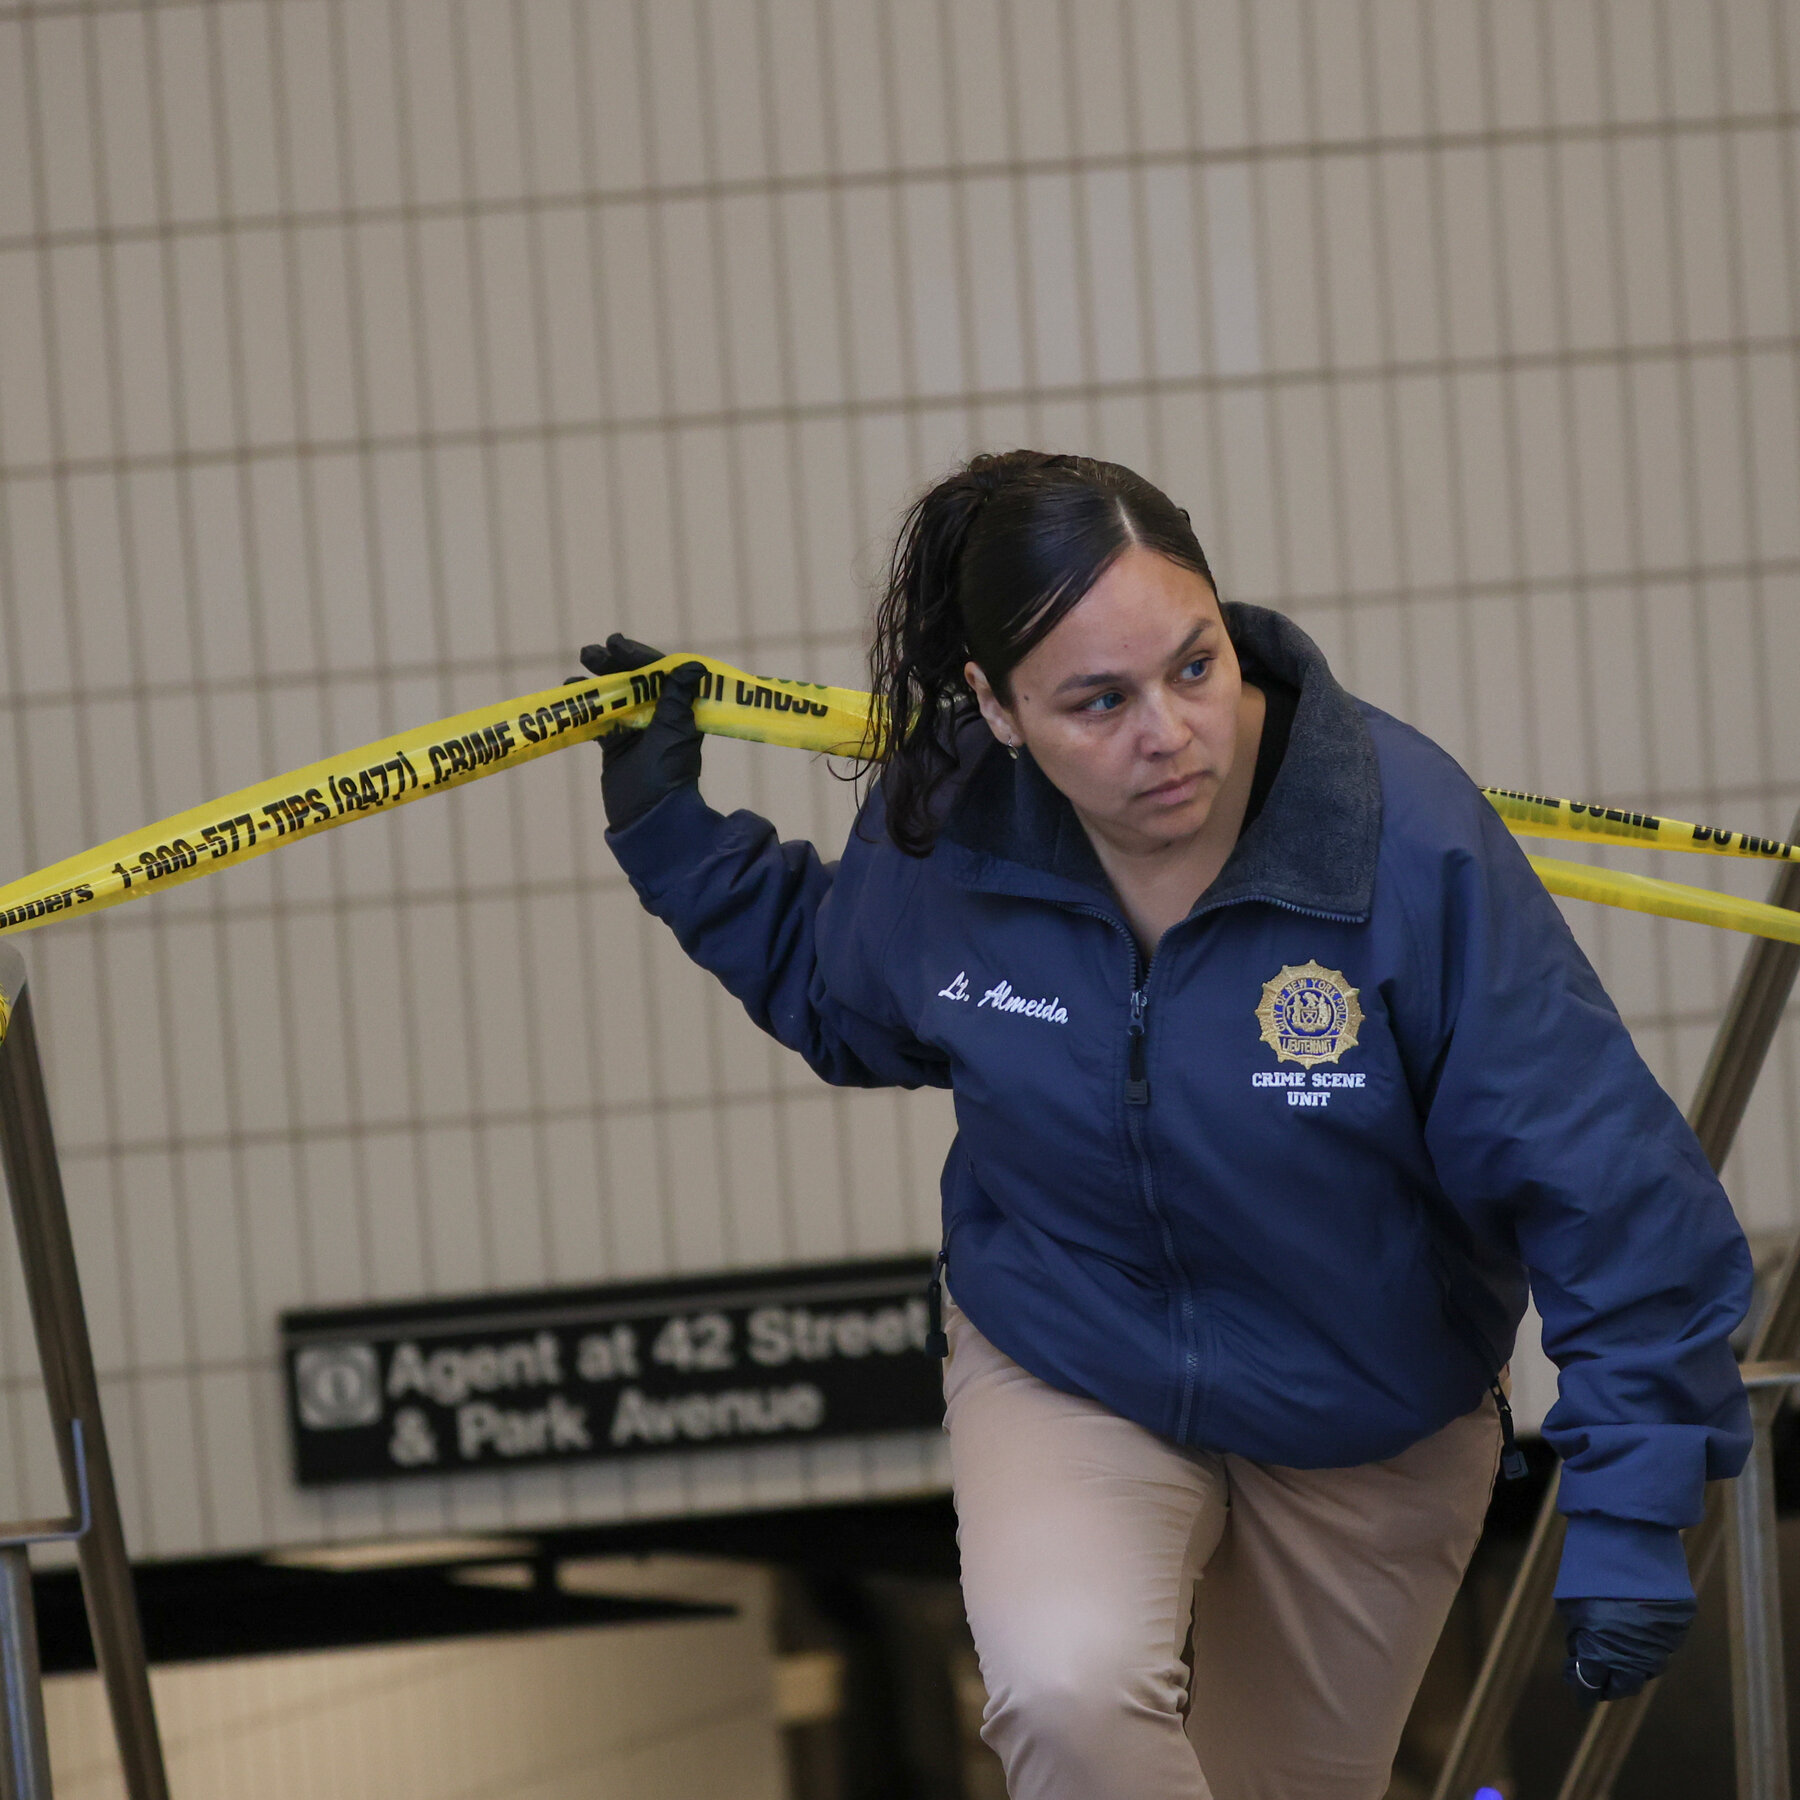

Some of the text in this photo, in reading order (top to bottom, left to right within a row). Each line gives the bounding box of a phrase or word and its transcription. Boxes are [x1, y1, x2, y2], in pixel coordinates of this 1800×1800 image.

[111, 788, 331, 889] 1-800-577-TIPS
[428, 701, 516, 785] CRIME
[518, 688, 604, 745] SCENE
[938, 971, 1068, 1024] Lt. Almeida
[1273, 1010, 1286, 1032] CITY
[1285, 979, 1307, 993] NEW
[1311, 979, 1338, 1000] YORK
[1333, 998, 1347, 1032] POLICE
[1282, 1038, 1332, 1054] LIEUTENANT
[1252, 1072, 1366, 1088] CRIME SCENE
[1287, 1091, 1331, 1106] UNIT
[387, 1299, 930, 1403] Agent at 42 Street
[391, 1383, 822, 1465] & Park Avenue
